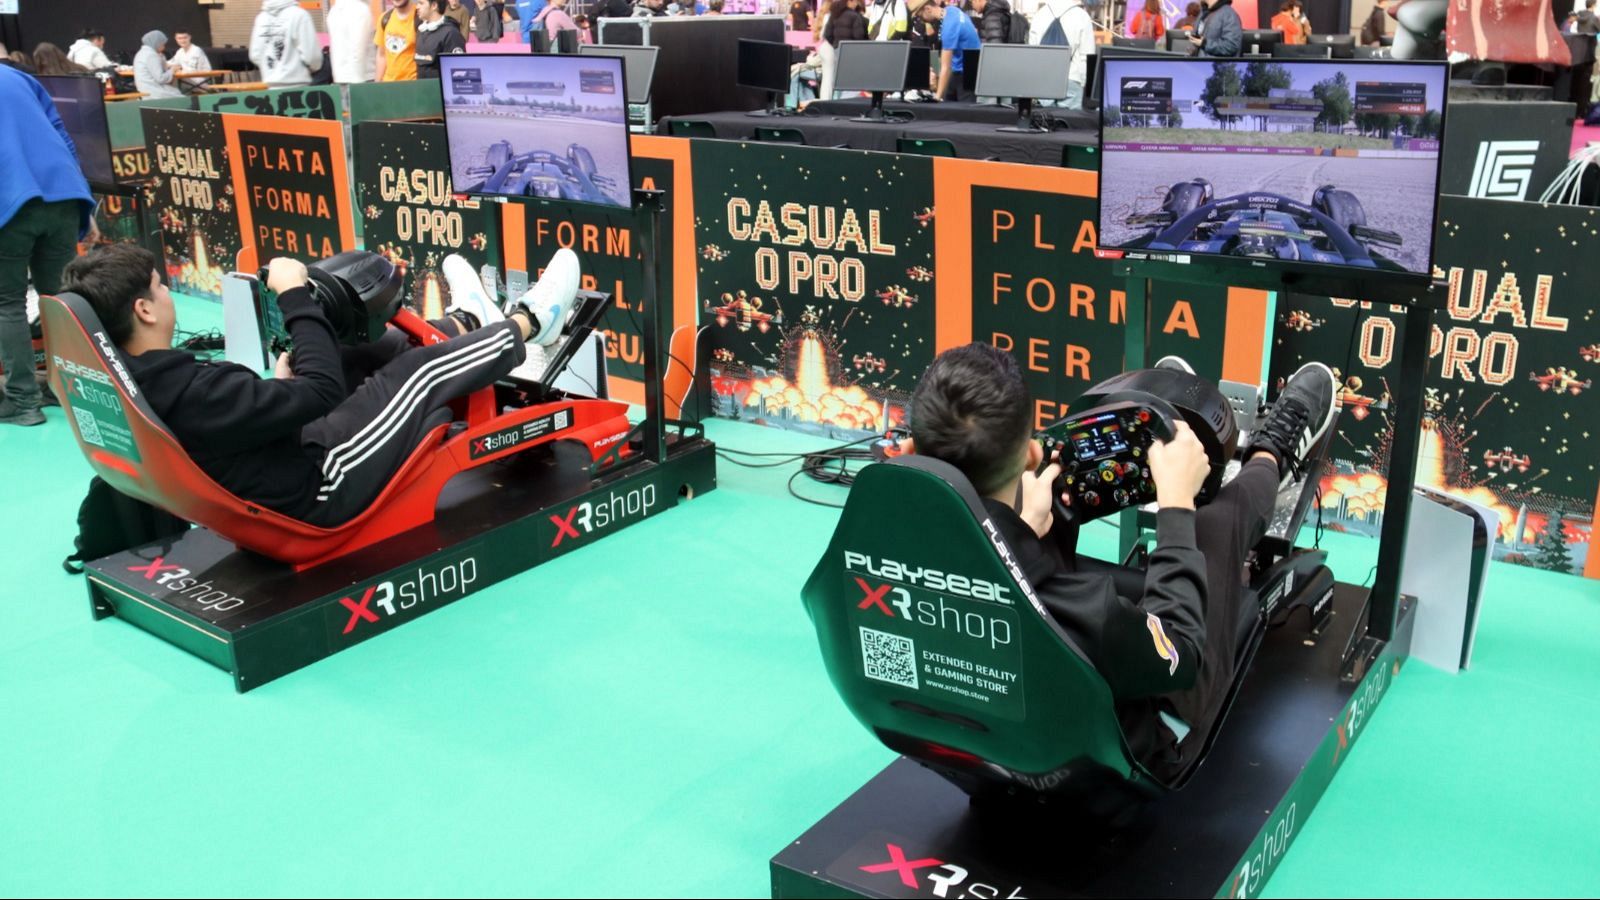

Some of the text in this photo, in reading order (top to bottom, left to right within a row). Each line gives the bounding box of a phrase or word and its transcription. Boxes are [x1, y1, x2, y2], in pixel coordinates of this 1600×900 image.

[112, 152, 150, 176] ASU
[156, 144, 220, 179] CASUAL
[247, 145, 325, 176] PLATA
[170, 177, 183, 206] O
[181, 178, 213, 211] PRO
[254, 186, 331, 219] FORMA
[259, 225, 334, 259] PER LA
[396, 206, 463, 248] O PRO
[536, 218, 643, 259] FORM
[727, 197, 896, 256] CASUAL
[992, 208, 1098, 254] PLA
[755, 247, 865, 302] O PRO
[1359, 316, 1396, 369] O
[473, 430, 519, 454] XRshop
[550, 483, 656, 547] XRshop
[127, 556, 244, 612] XRshop
[339, 557, 477, 635] XRshop
[855, 577, 1011, 650] XRshop
[923, 650, 1017, 683] EXTENDED REALITY
[924, 664, 1008, 695] & GAMING STORE
[1332, 662, 1387, 766] XRshop
